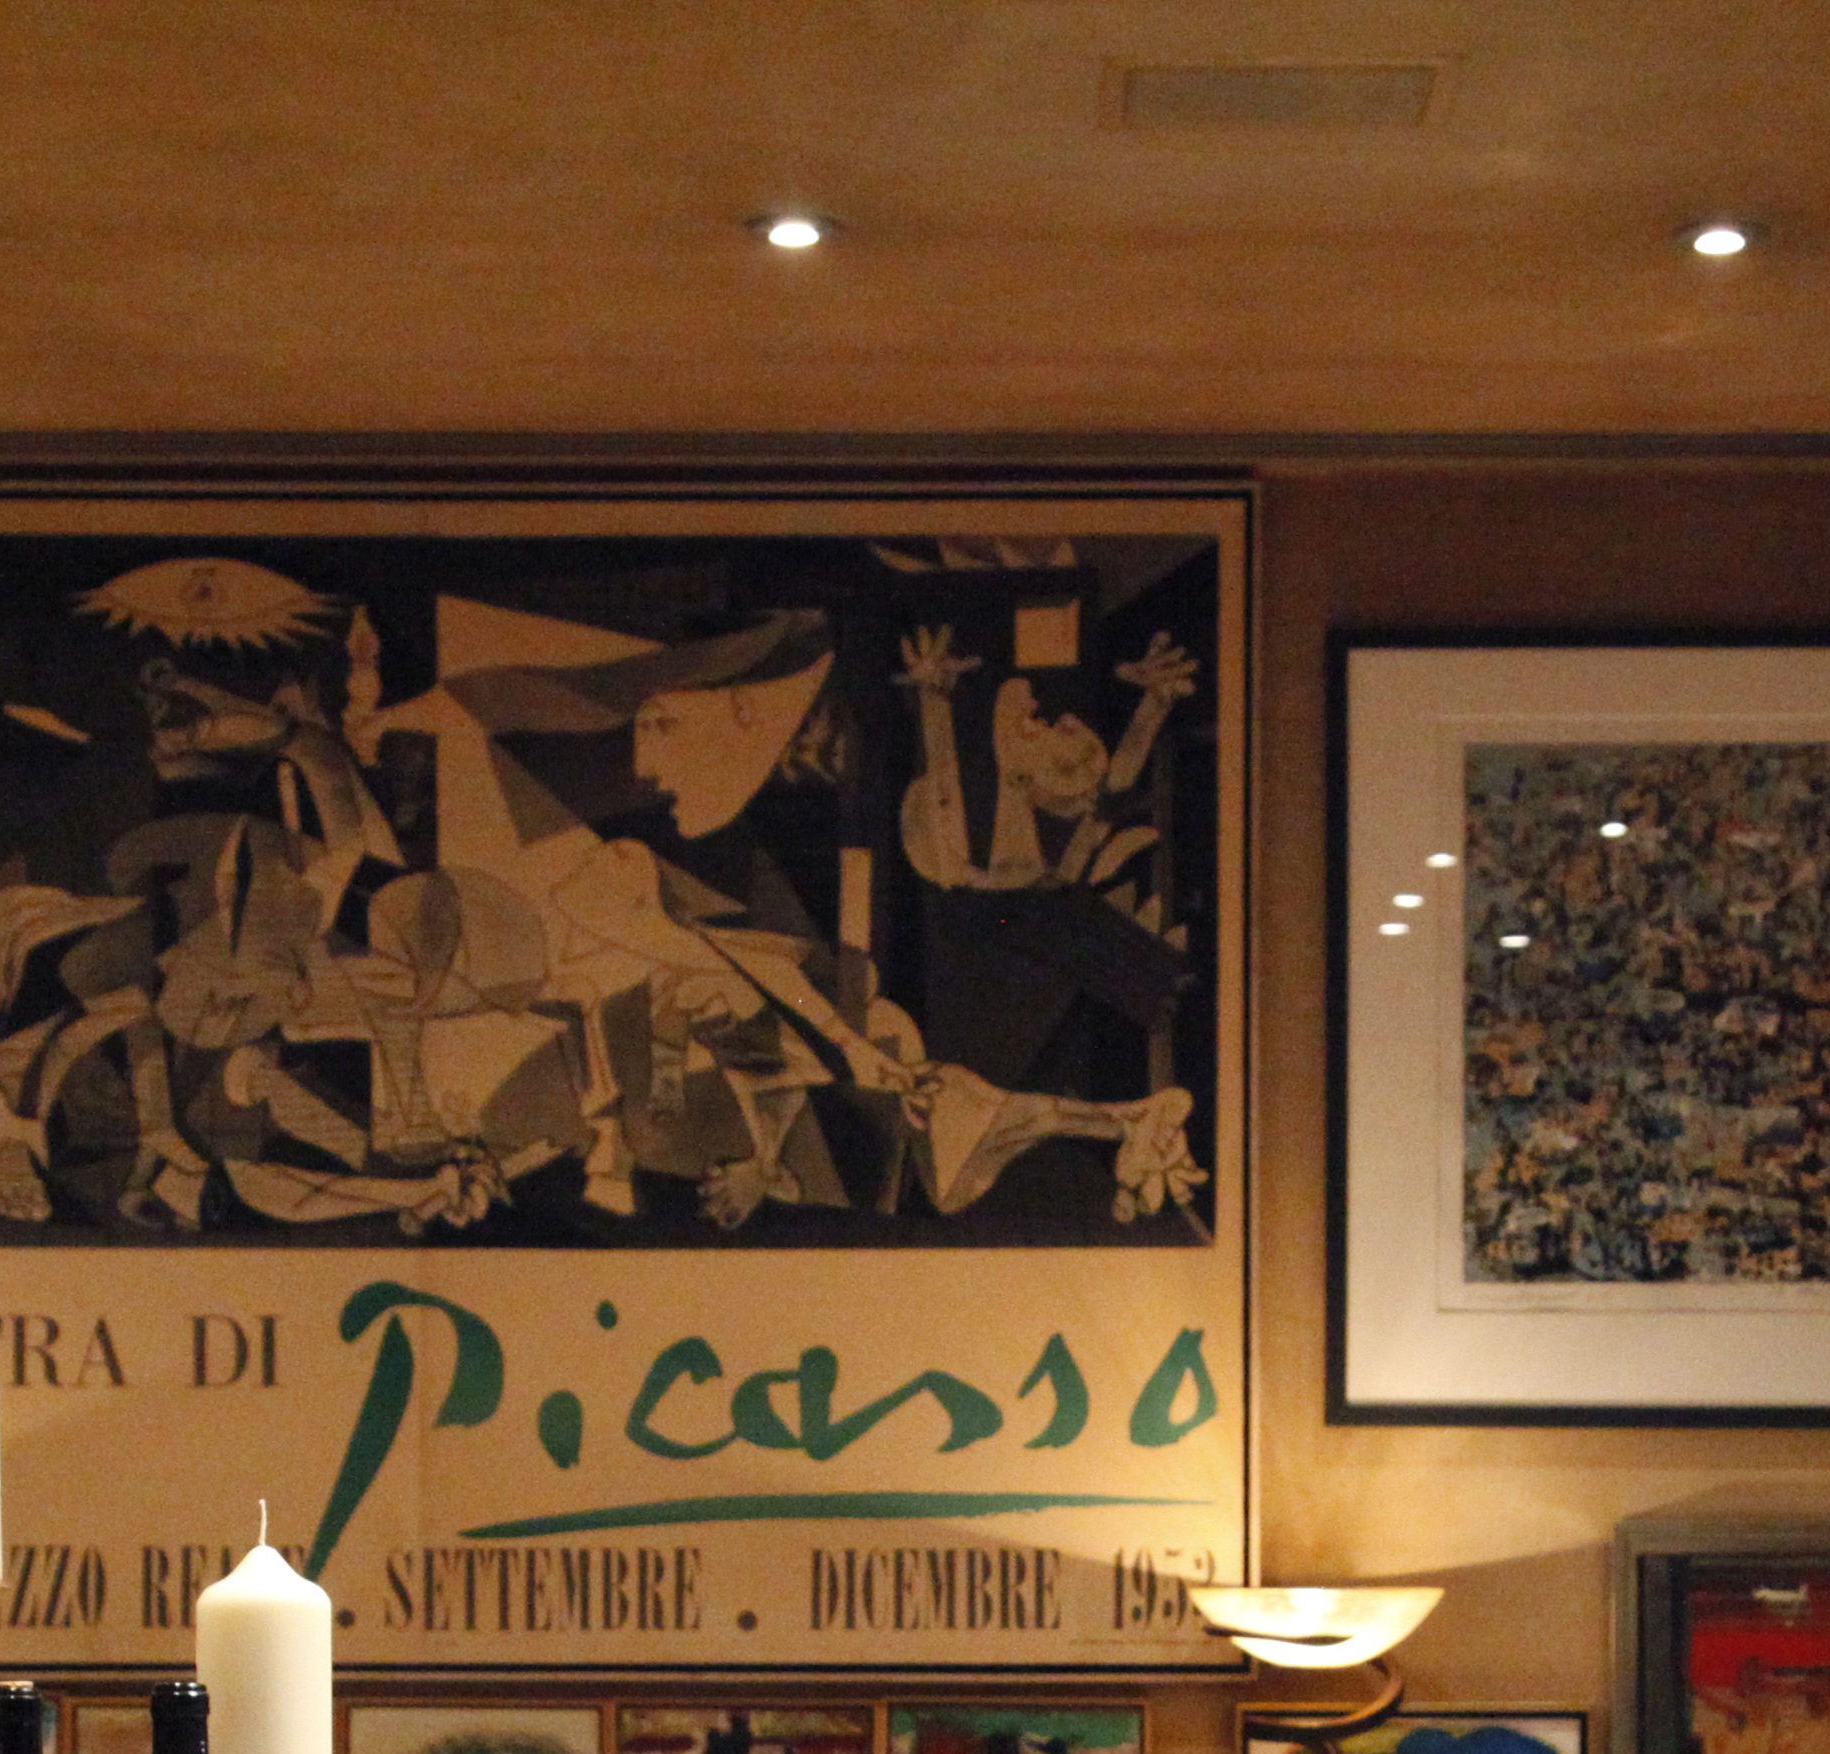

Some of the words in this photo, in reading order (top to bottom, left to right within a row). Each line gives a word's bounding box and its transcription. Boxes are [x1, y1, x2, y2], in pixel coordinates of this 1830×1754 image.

[191, 1314, 281, 1388] DI
[303, 1279, 1217, 1583] Picasso
[385, 1546, 701, 1631] SETTEMBRE
[810, 1547, 1062, 1631] DICEMBRE
